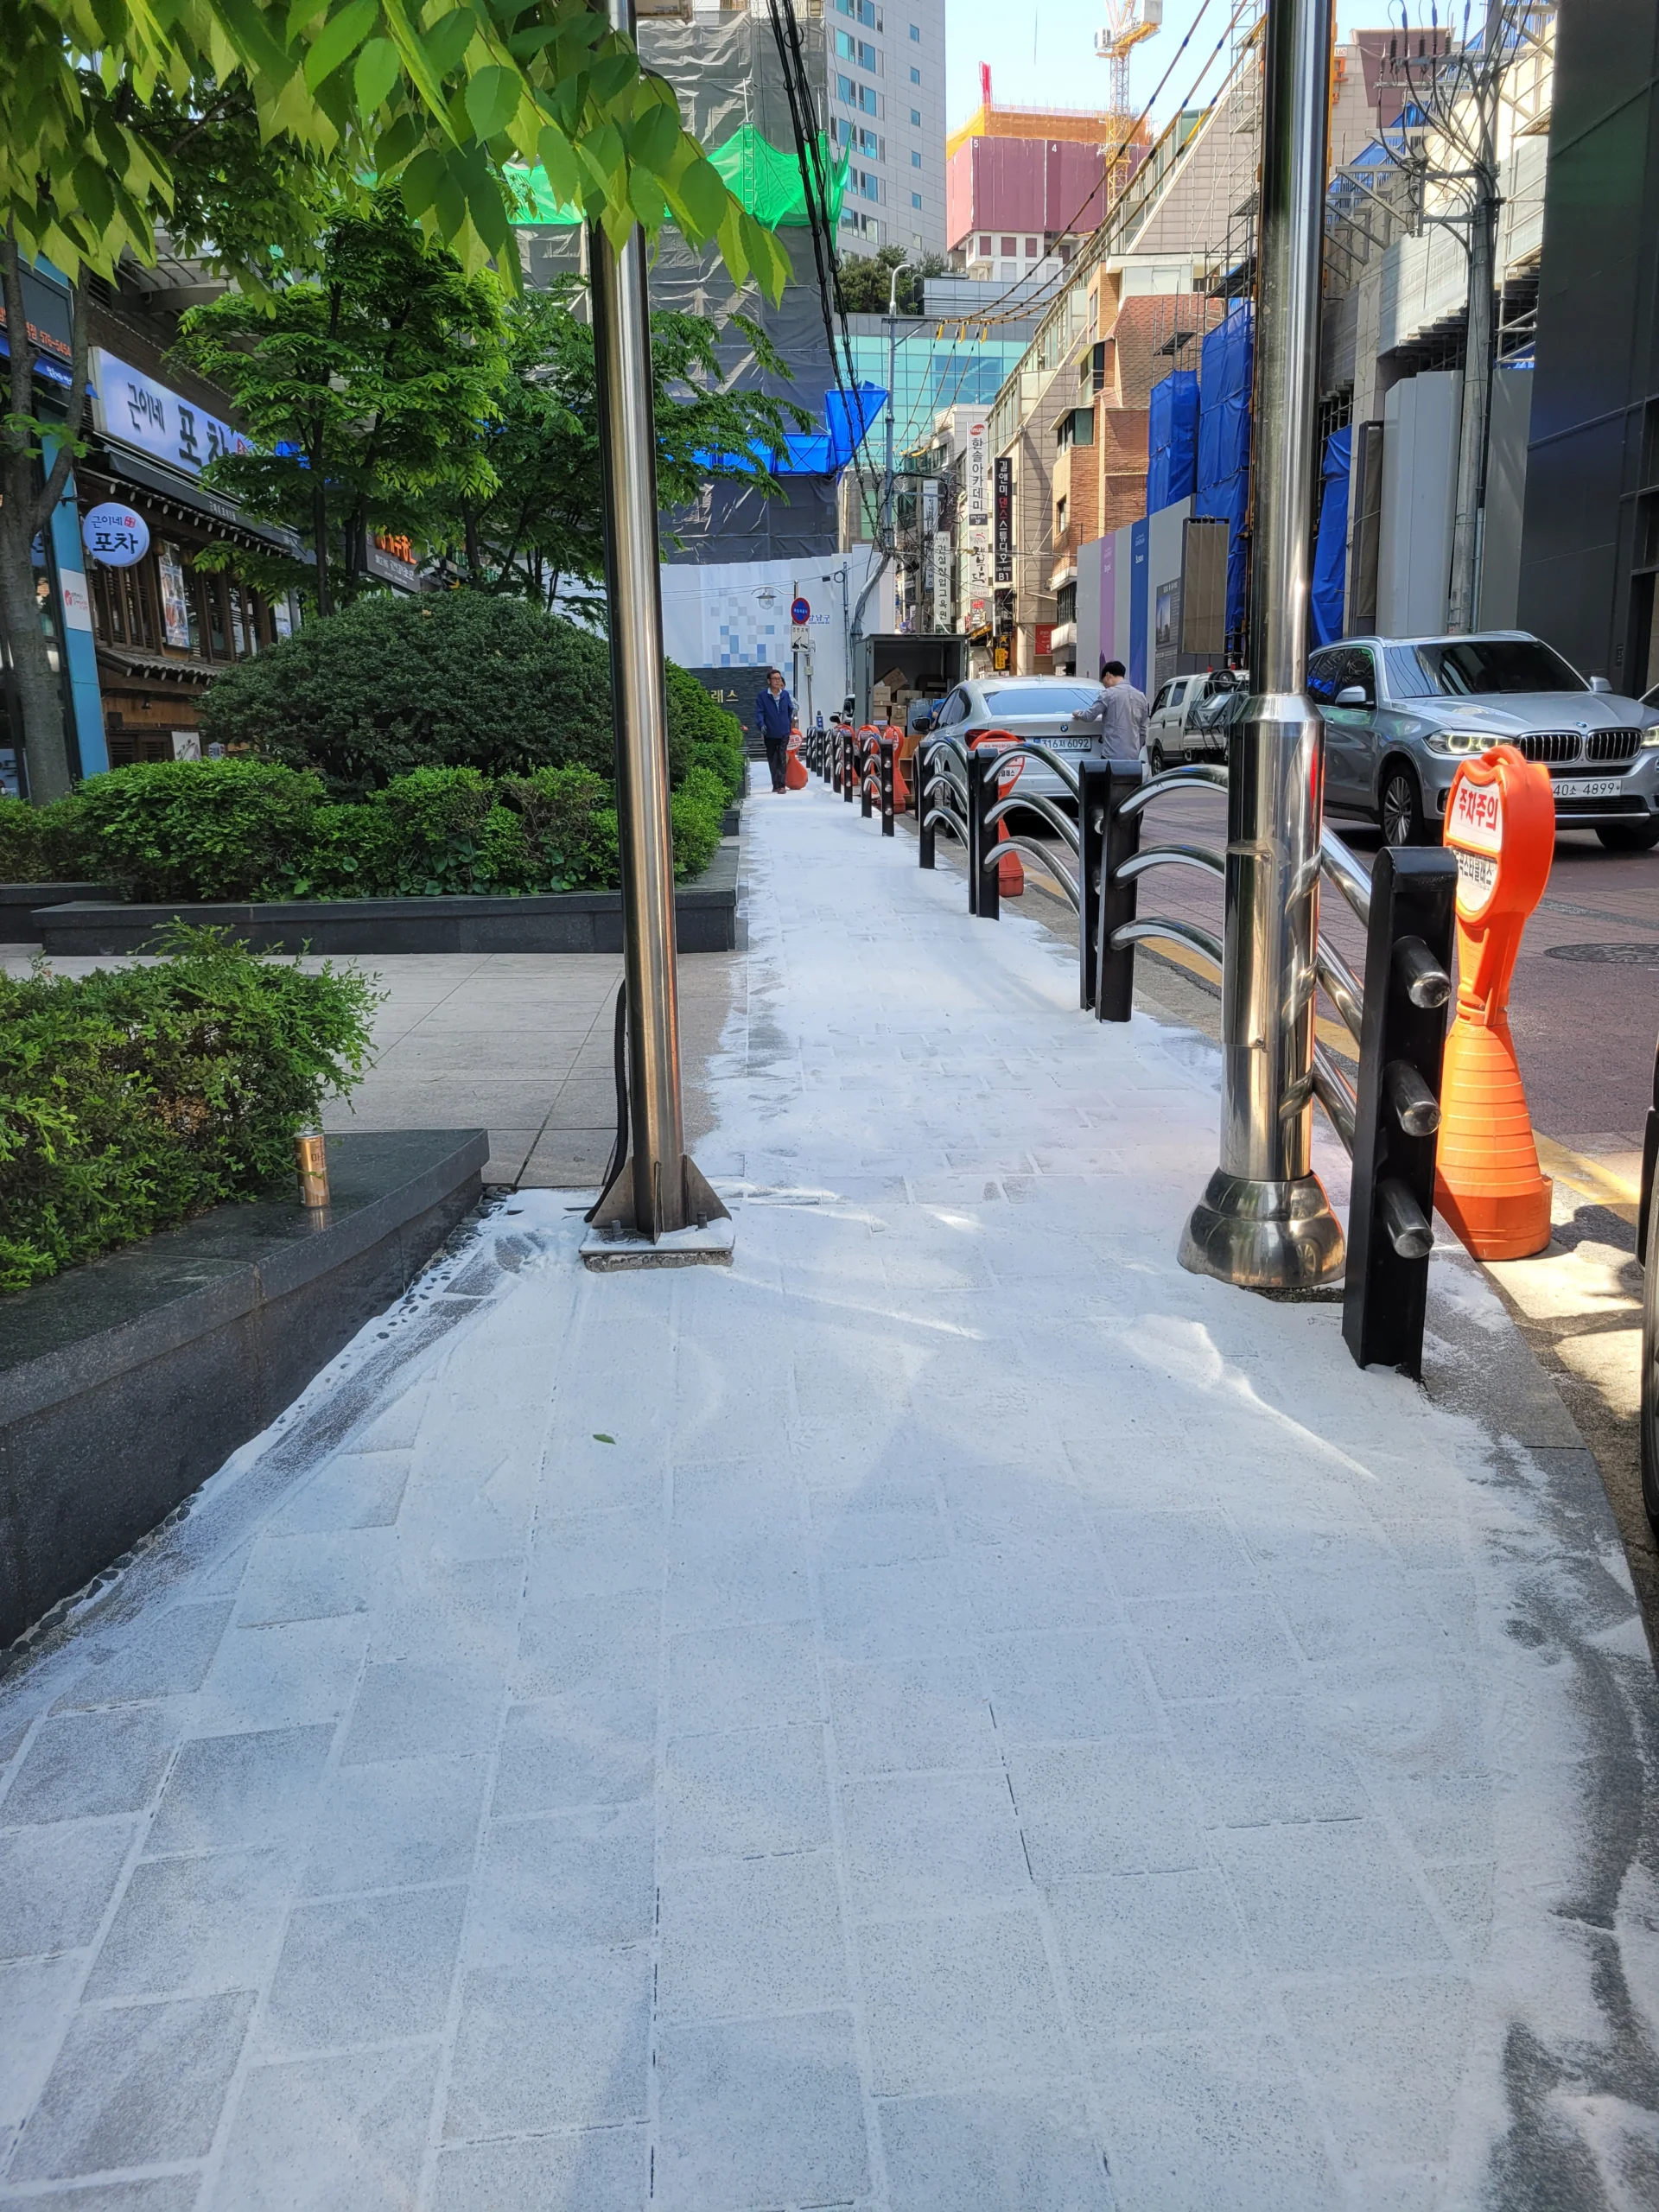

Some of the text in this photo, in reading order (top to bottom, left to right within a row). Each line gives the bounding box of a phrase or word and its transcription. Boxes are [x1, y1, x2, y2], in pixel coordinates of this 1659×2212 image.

[973, 139, 979, 148] 5
[1052, 143, 1058, 153] 4
[127, 381, 235, 468] 근이네 포차
[972, 437, 984, 512] 한솔아카데미
[998, 461, 1008, 496] 길앤미
[91, 515, 123, 529] 근이네
[92, 532, 139, 554] 포차
[938, 544, 948, 620] 건설산업교육원
[998, 572, 1009, 581] B1
[710, 689, 740, 703] 래스
[1041, 739, 1090, 748] 316저 6092
[1552, 782, 1615, 796] 40소 4899
[1459, 787, 1498, 831] 주차주의
